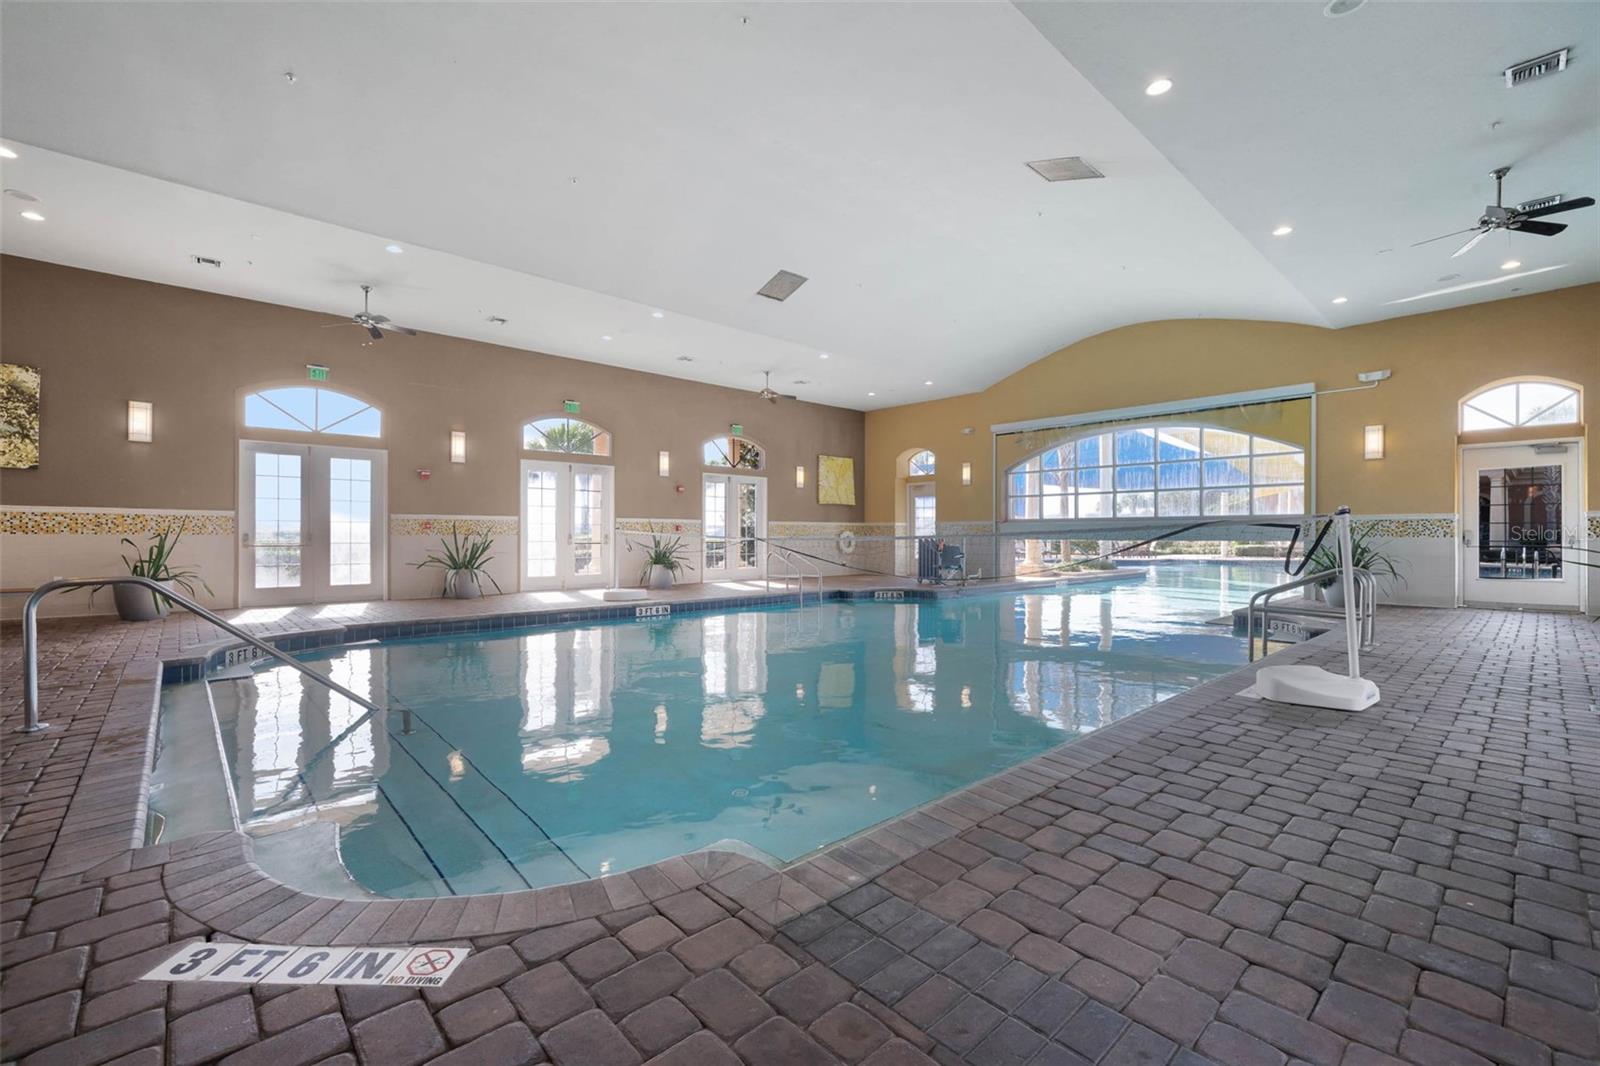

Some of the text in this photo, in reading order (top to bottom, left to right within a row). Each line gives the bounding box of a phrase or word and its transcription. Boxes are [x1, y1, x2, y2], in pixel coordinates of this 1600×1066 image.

[1281, 623, 1291, 632] FT
[228, 652, 234, 663] 3
[237, 648, 248, 662] FT
[169, 948, 396, 979] 3 FT. 6 IN.
[386, 975, 443, 985] NO DIVING
